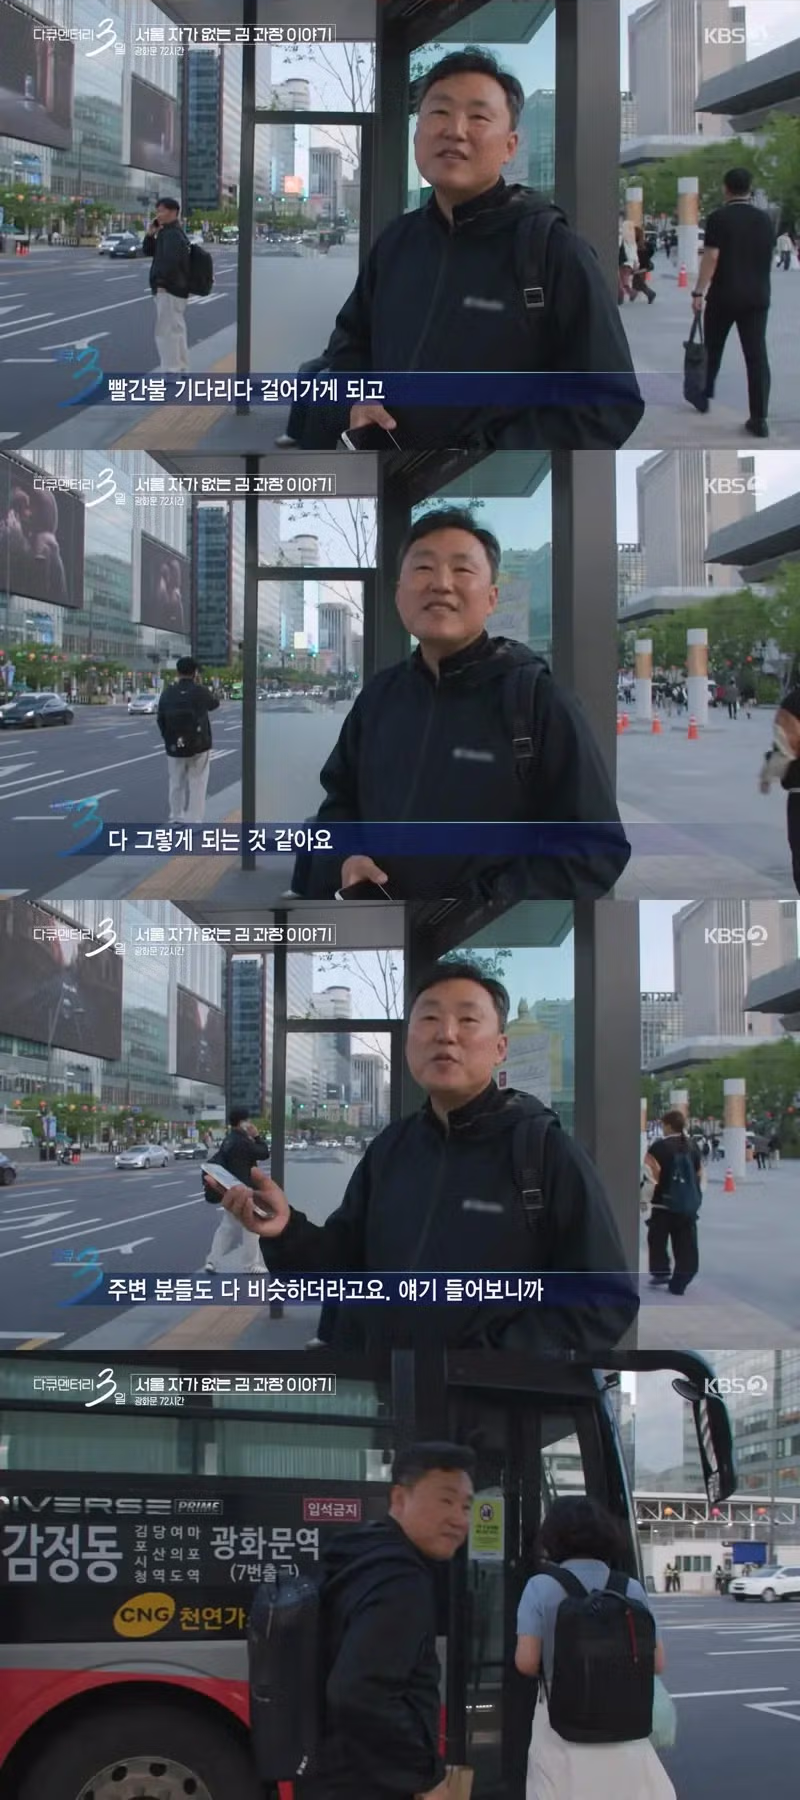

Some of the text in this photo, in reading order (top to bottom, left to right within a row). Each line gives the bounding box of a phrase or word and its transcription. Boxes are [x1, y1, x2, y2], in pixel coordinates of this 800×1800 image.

[177, 1500, 221, 1514] PRIME
[307, 1502, 358, 1518] 입석금지
[210, 1526, 320, 1561] 광화문역
[1, 1522, 124, 1584] 감정동
[120, 1607, 171, 1623] CNG
